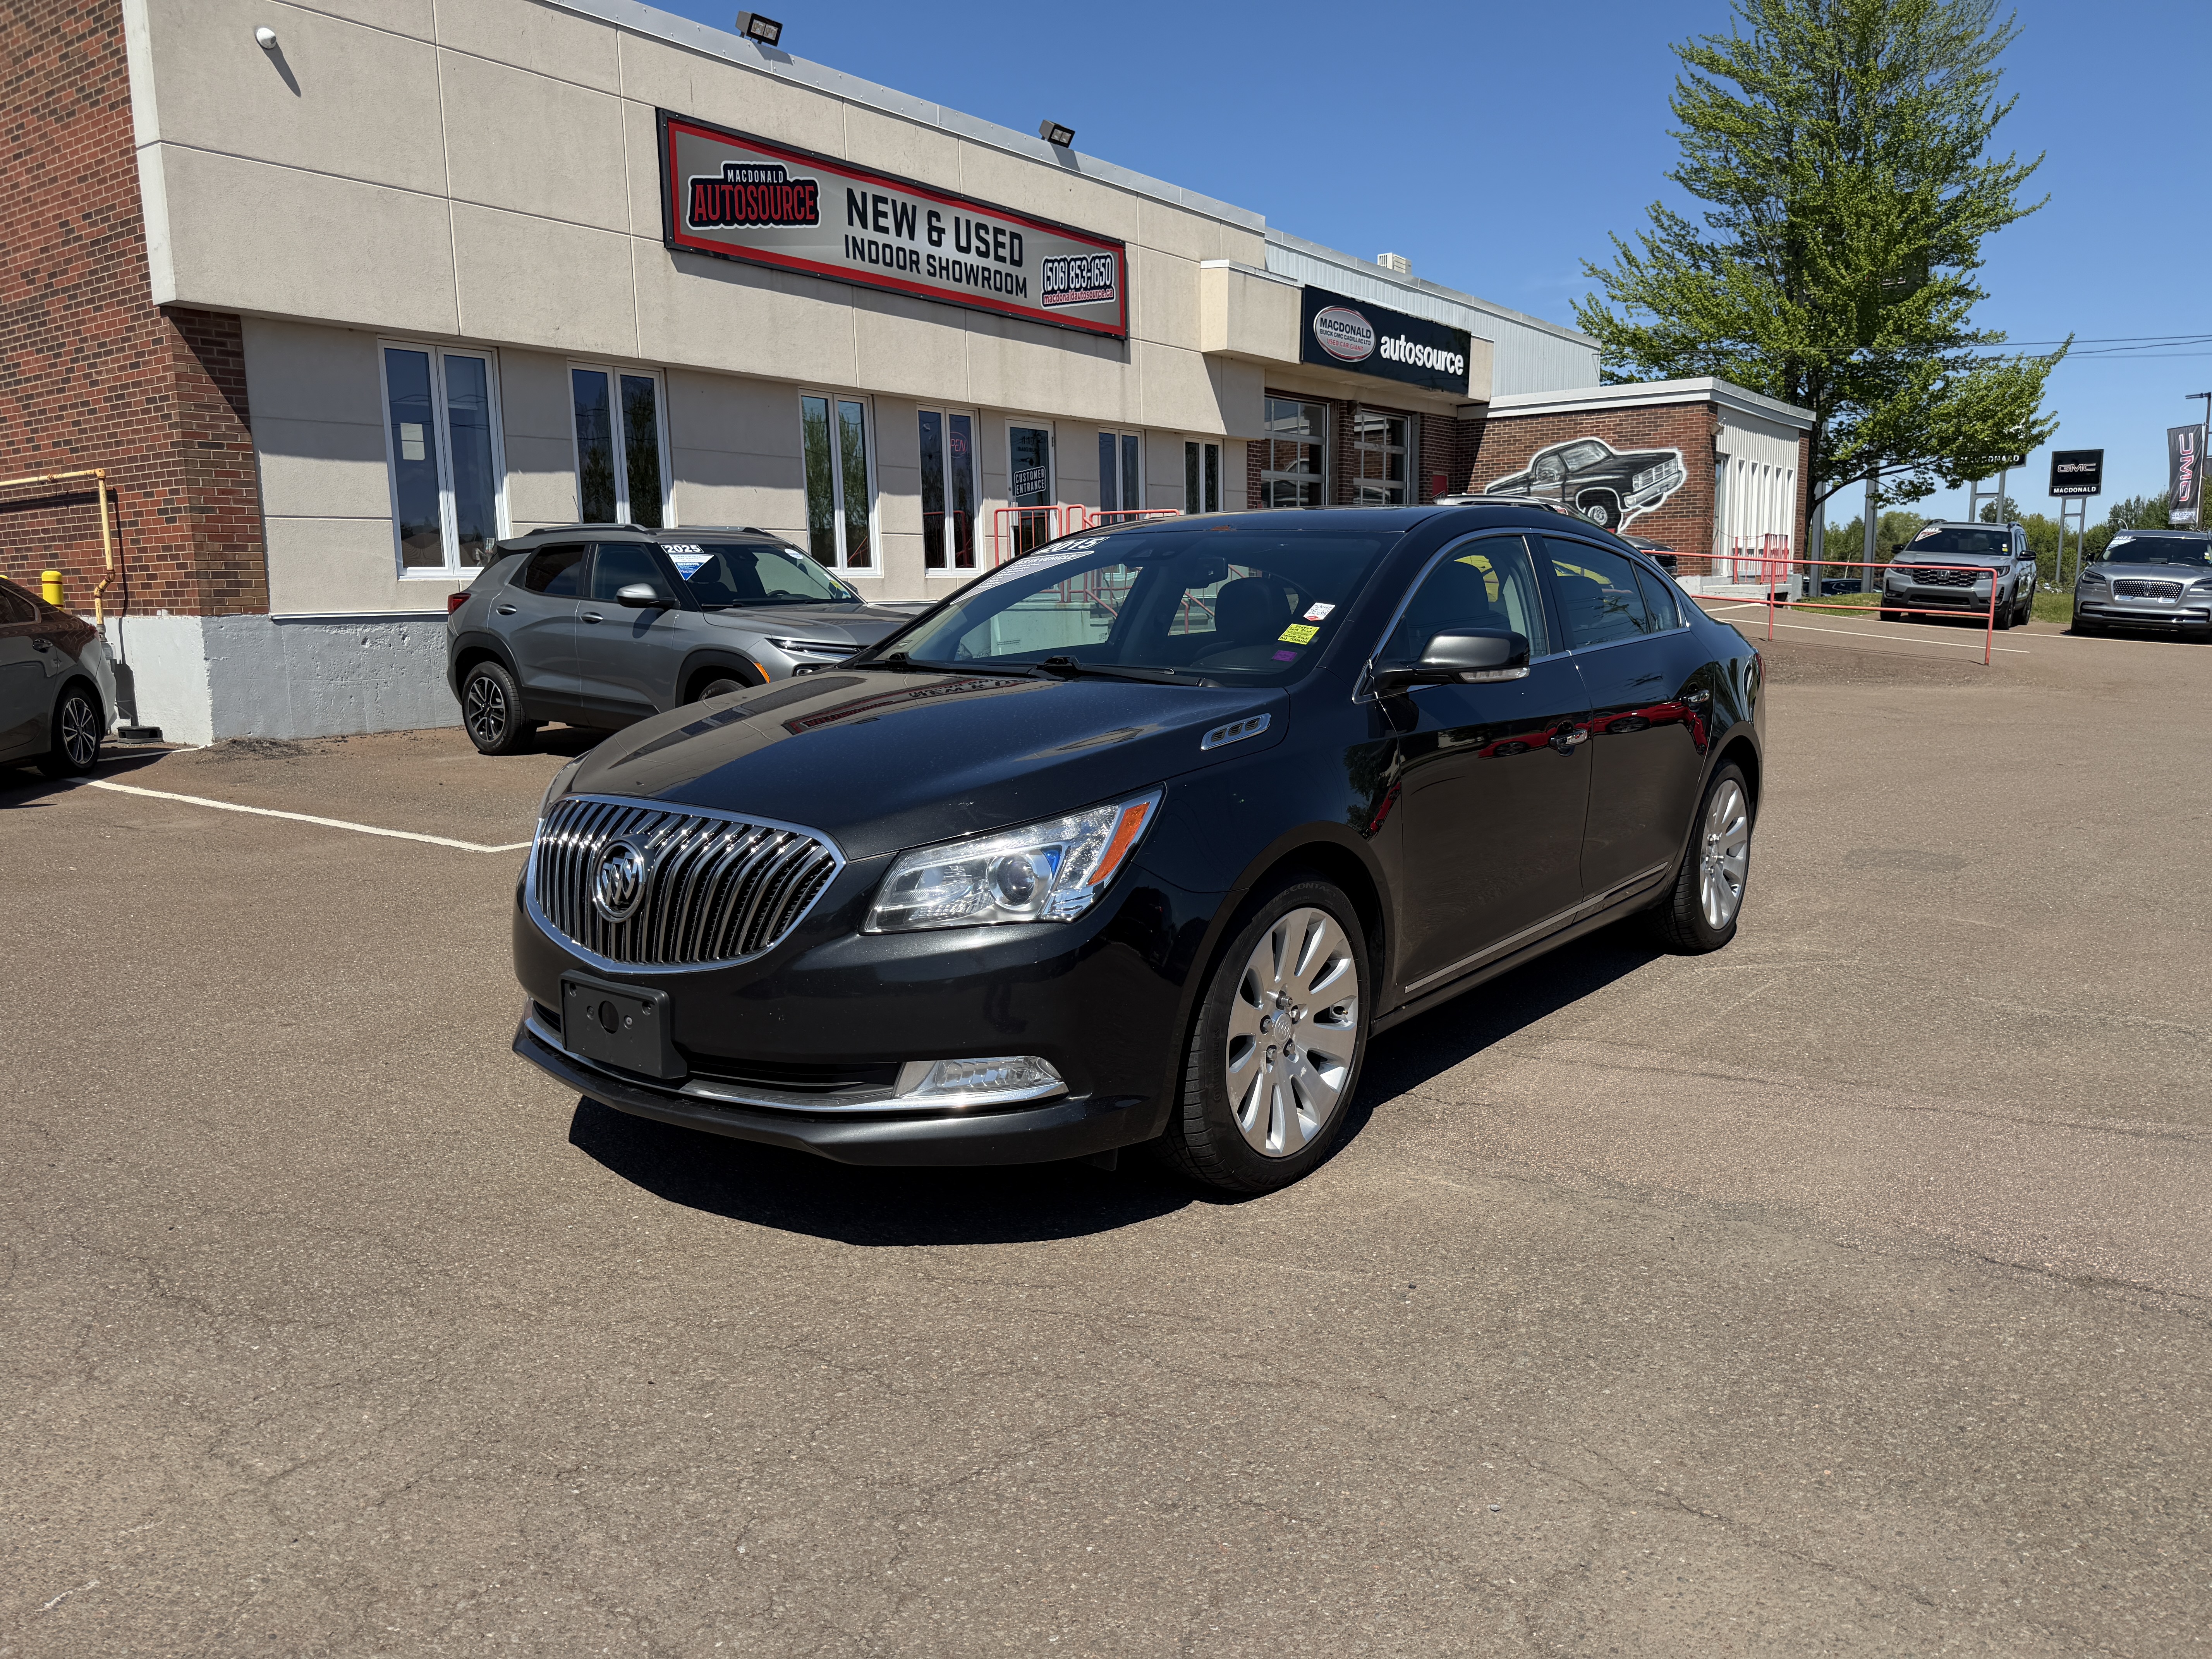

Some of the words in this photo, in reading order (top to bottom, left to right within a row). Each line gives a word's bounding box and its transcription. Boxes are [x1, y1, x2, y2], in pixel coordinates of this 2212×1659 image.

[727, 169, 784, 184] MACDONALD
[694, 184, 816, 222] AUTOSOURCE
[846, 188, 917, 241] NEW
[927, 210, 946, 247] &
[955, 218, 1023, 268] USED
[845, 234, 921, 273] INDOOR
[927, 254, 1027, 298] SHOWROOM
[1044, 261, 1068, 292] (506)
[1070, 258, 1111, 289] 853-1650
[1043, 288, 1113, 304] macdonaldautosource.ca
[1320, 318, 1371, 339] MACDONALD
[1344, 335, 1363, 343] CADILLAC
[1380, 335, 1464, 376] autosource
[950, 438, 966, 452] PEN
[1015, 468, 1045, 484] CUSTOMER
[2057, 463, 2096, 473] GMC
[1016, 479, 1044, 495] ENTRANCE
[1036, 538, 1105, 553] 2015
